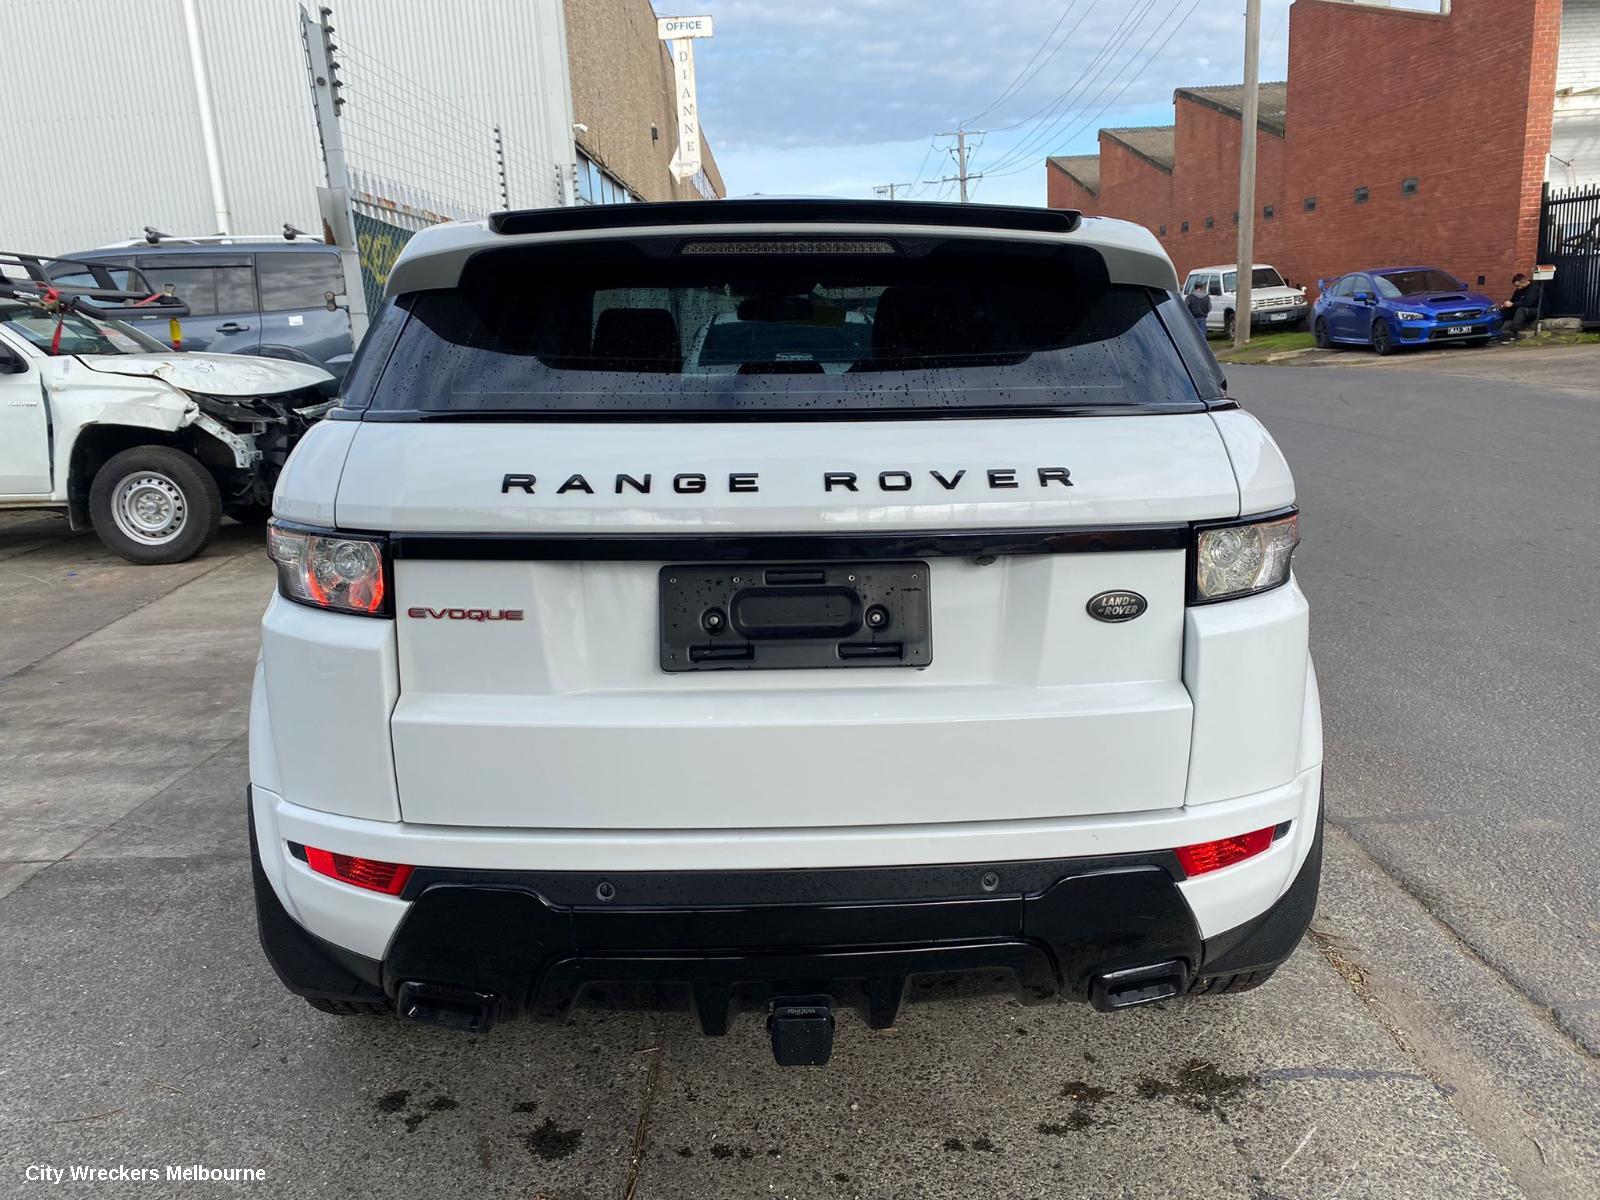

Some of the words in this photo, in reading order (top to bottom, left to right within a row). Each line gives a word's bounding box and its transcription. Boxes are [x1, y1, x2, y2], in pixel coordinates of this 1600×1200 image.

[666, 20, 702, 31] OFFICE
[501, 472, 759, 495] RANGE
[824, 467, 1074, 492] ROVER
[408, 607, 524, 622] EVOQUE
